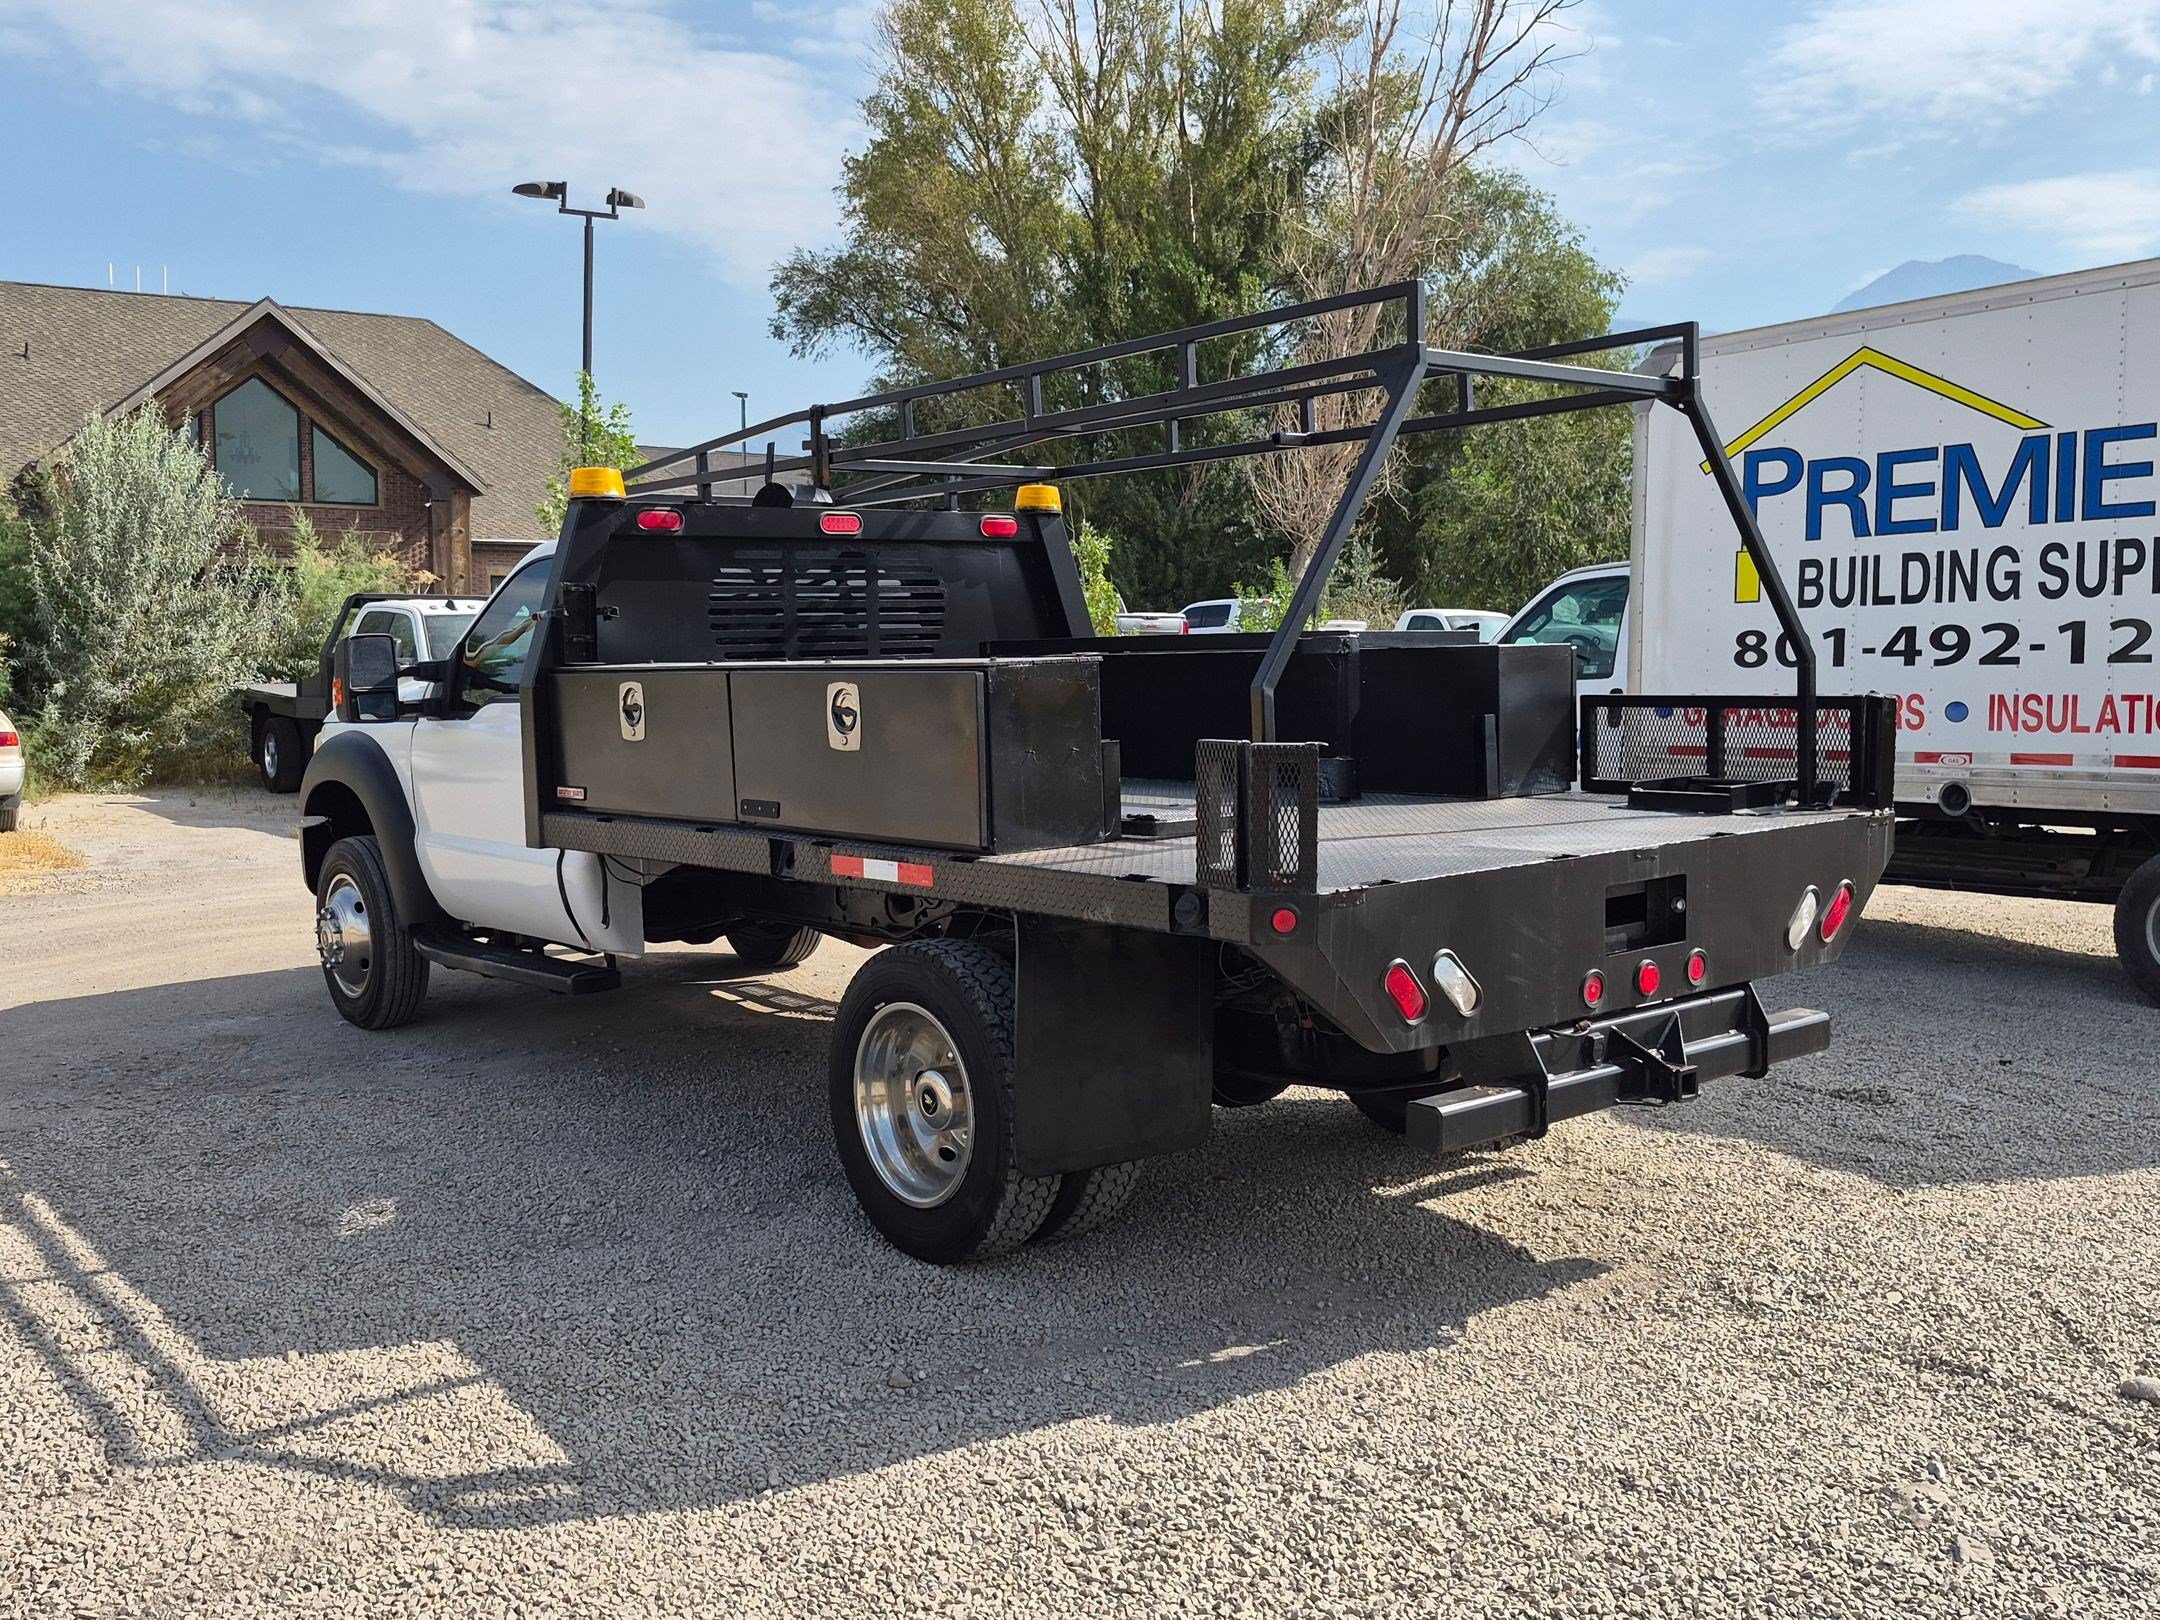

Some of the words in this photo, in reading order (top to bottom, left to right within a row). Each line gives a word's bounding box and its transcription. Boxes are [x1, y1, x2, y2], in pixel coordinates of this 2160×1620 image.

[1742, 422, 2158, 541] PREMIE
[1797, 545, 2021, 609] BUILDING
[2038, 537, 2160, 600] SUP
[1988, 693, 2160, 735] INSULATI
